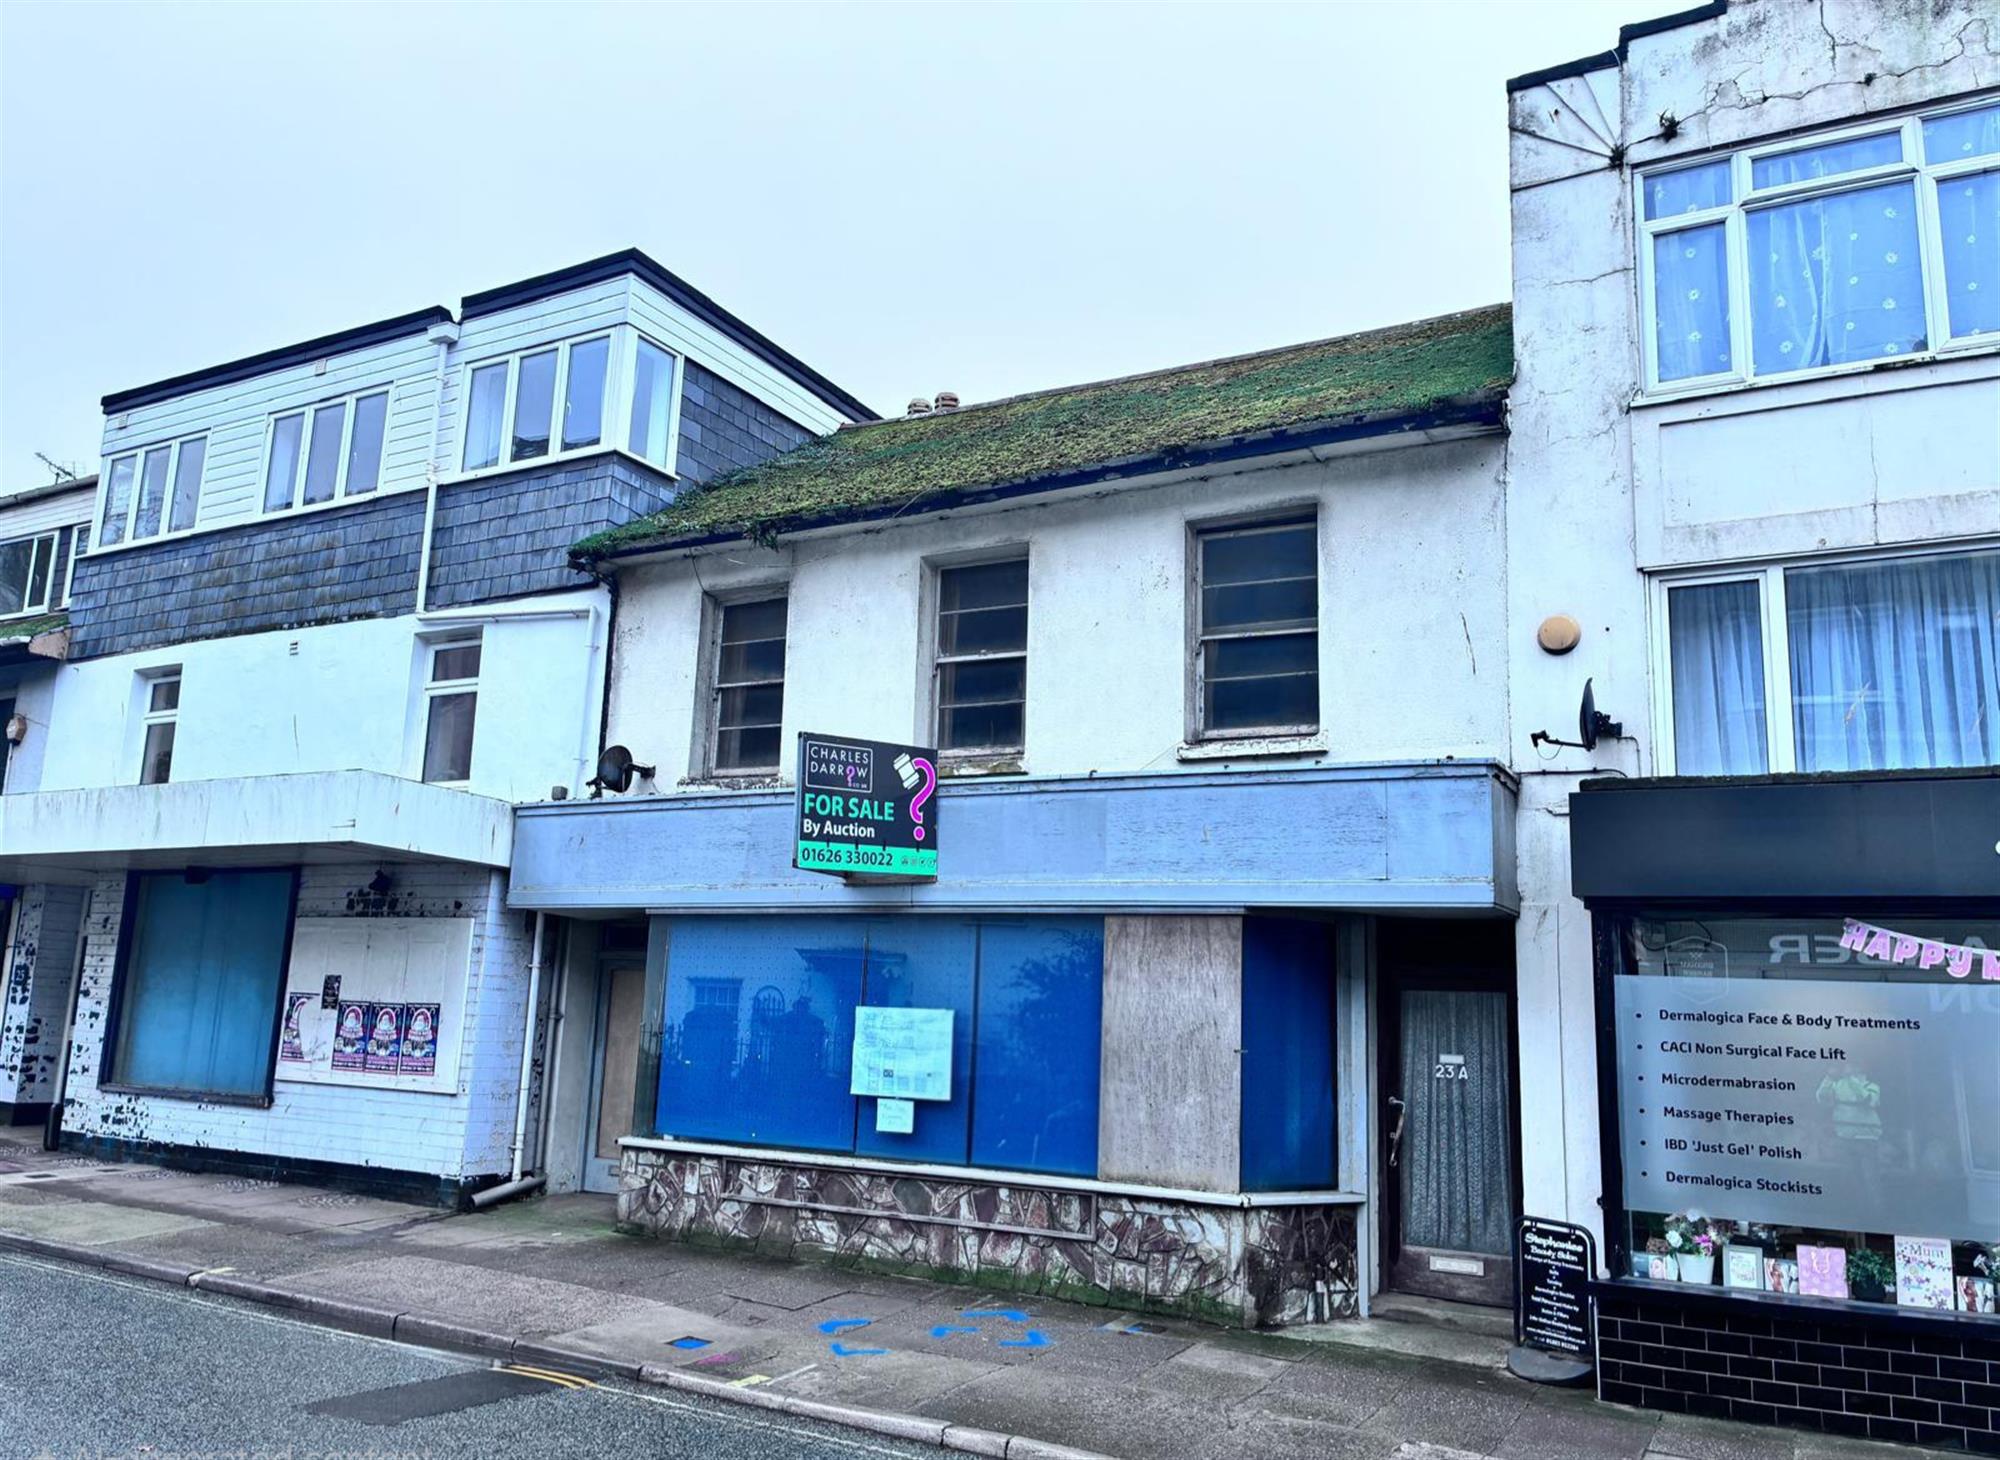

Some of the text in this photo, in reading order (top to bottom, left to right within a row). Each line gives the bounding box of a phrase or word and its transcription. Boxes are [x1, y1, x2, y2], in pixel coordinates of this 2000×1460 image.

[810, 746, 868, 764] CHARLES
[804, 793, 894, 821] FOR SALE
[803, 818, 875, 838] By Auction
[802, 848, 893, 866] 01626 330022
[1840, 920, 1973, 978] HAPPY
[1659, 1009, 1921, 1030] Dermalogica Face & Body Treatments
[1660, 1041, 1846, 1060] CACI Non Surgical Face Lift
[1661, 1073, 1796, 1091] Microdermabrasion
[1663, 1106, 1795, 1126] Massage Therapies
[1664, 1138, 1688, 1151] IBD
[1759, 1145, 1803, 1159] Polish
[1665, 1171, 1823, 1195] Dermalogica Stockists
